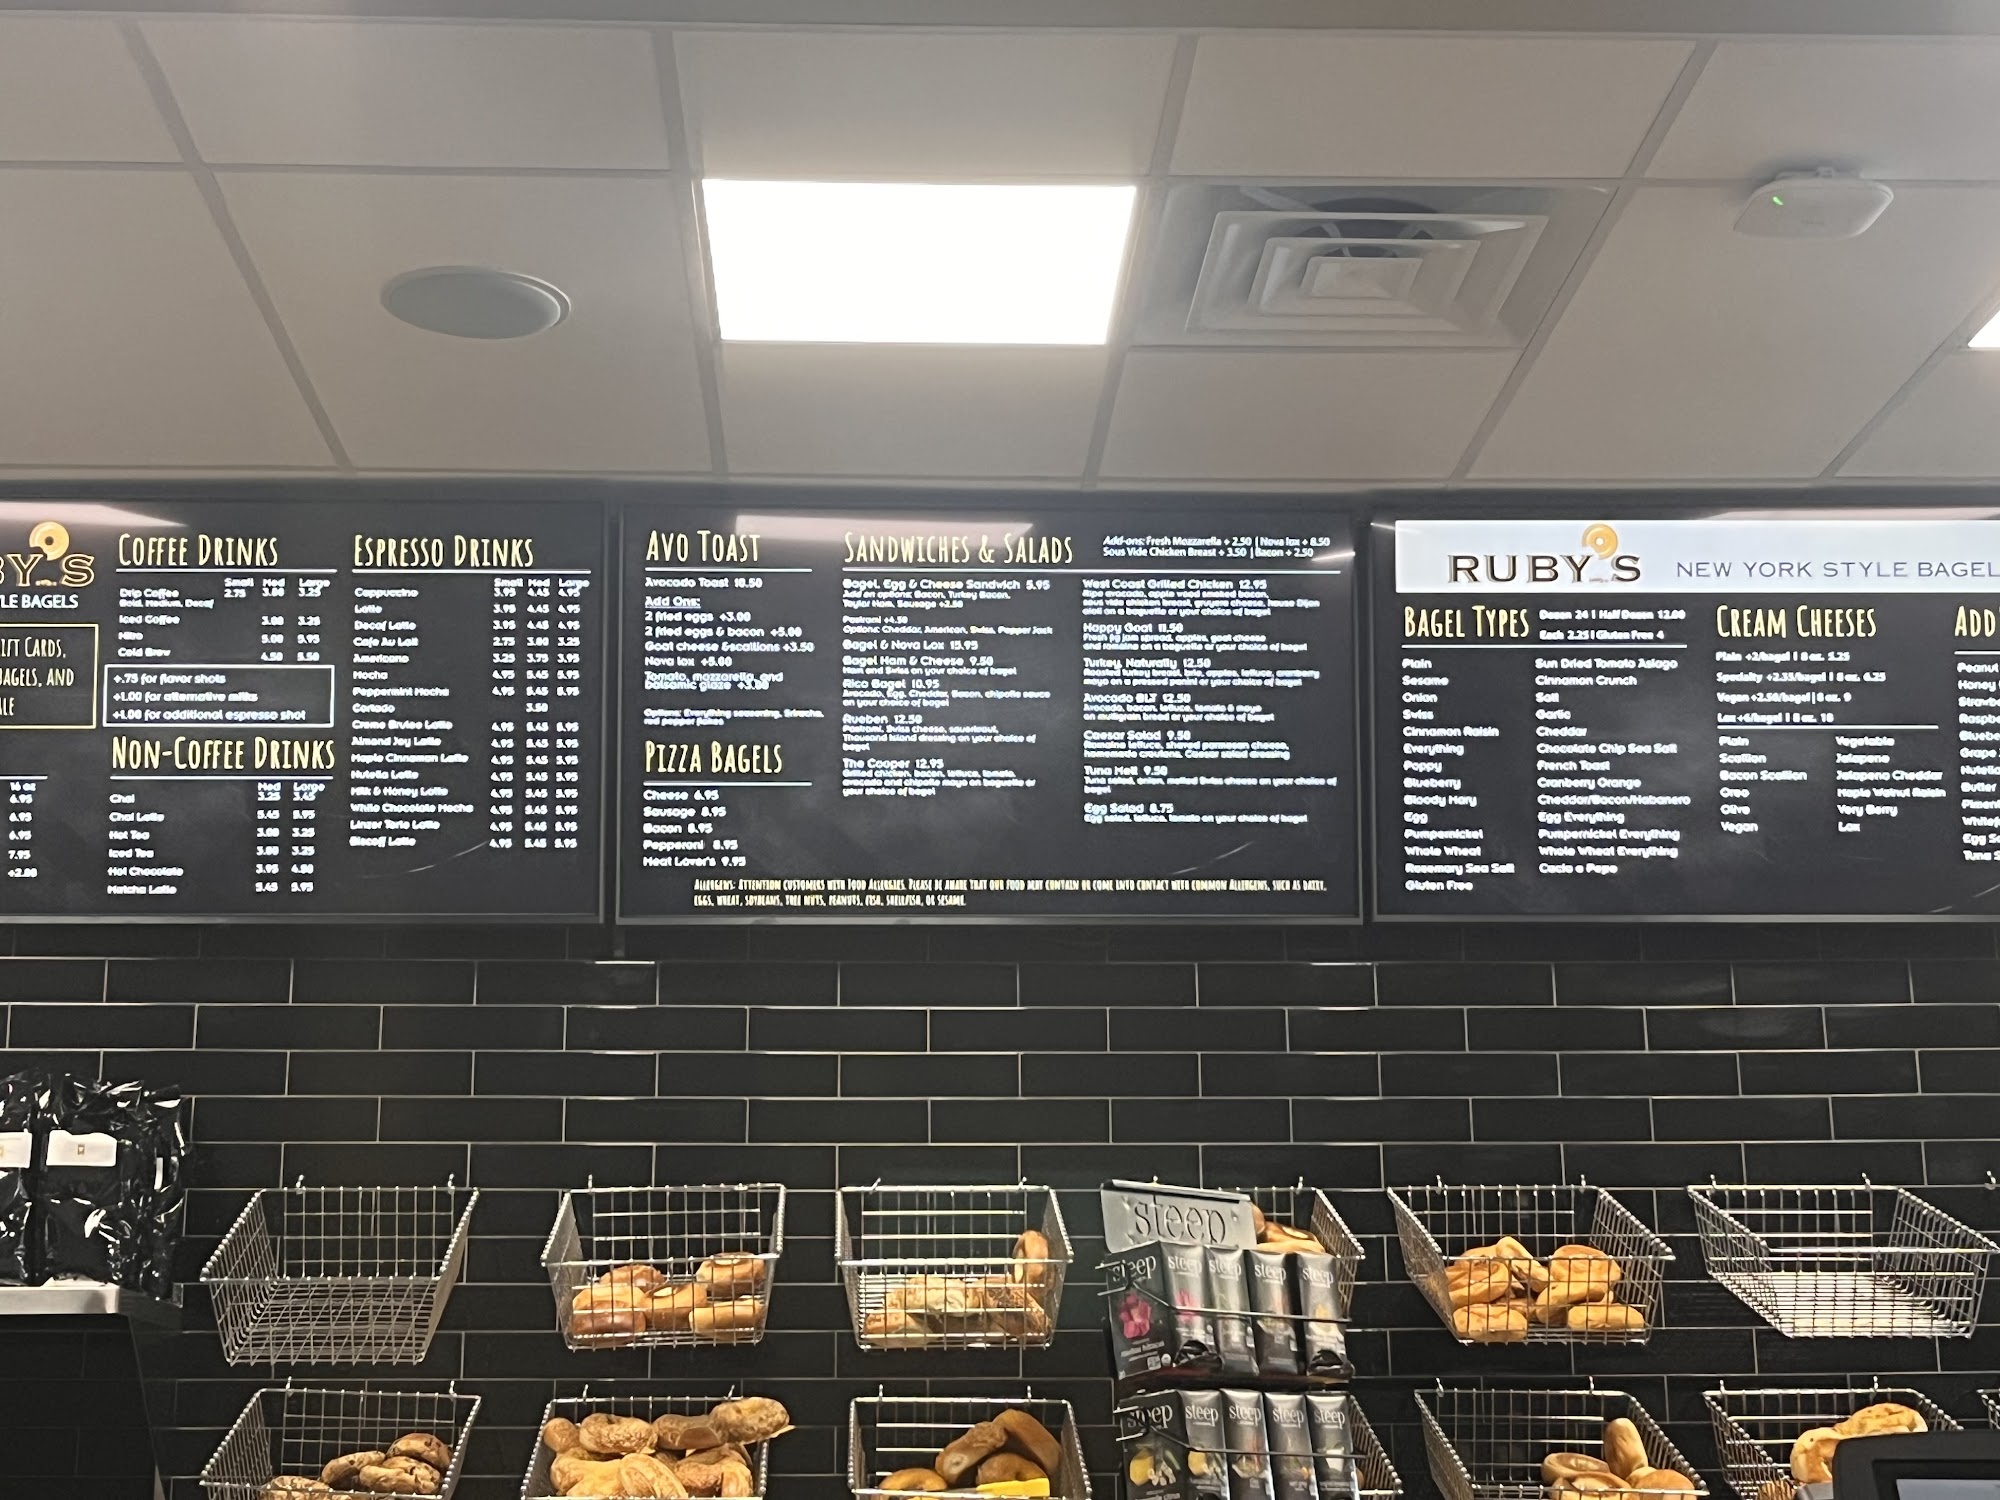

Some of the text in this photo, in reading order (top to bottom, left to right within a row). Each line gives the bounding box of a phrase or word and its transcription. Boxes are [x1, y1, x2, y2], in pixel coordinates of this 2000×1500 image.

[646, 529, 762, 562] AVO TOAST
[842, 530, 1072, 563] SANDWICHES & SALADS
[1146, 536, 1171, 548] Fresh
[1232, 537, 1253, 548] 2.50
[119, 533, 277, 566] COFFEE DRINKS
[355, 535, 533, 567] ESPRESSO DRINKS
[1147, 547, 1186, 556] Chicken
[1188, 547, 1216, 556] Breast
[1294, 548, 1315, 559] 2.50
[1676, 561, 1732, 579] NEW
[1743, 561, 1812, 579] YORK
[1823, 561, 1908, 579] STYLE
[645, 577, 696, 587] Avocado
[698, 577, 729, 587] Toast
[918, 579, 963, 592] Cheese
[966, 579, 1020, 592] Sandwich
[1082, 579, 1110, 591] West
[1112, 579, 1145, 591] Coast
[1147, 579, 1185, 591] Grilled
[1188, 579, 1235, 591] Chicken
[144, 589, 179, 600] Coffee
[355, 588, 418, 598] Cappuccino
[0, 594, 78, 608] LE BAGELS
[645, 596, 671, 608] Add
[655, 611, 682, 623] fried
[684, 613, 714, 624] eggs
[720, 612, 751, 622] +3.00
[1405, 605, 1529, 637] BAGEL TYPES
[1717, 605, 1876, 638] CREAM CHEESES
[655, 626, 682, 638] fried
[684, 628, 713, 638] eggs
[727, 627, 764, 637] bacon
[25, 637, 66, 658] CARDS,
[645, 641, 674, 651] Goat
[676, 642, 719, 651] cheese
[891, 640, 920, 650] Nova
[923, 641, 944, 650] Lox
[645, 656, 674, 666] Nova
[677, 657, 694, 666] lox
[1535, 658, 1558, 668] Sun
[1561, 658, 1592, 668] Dried
[1594, 658, 1636, 668] Tomato
[46, 668, 74, 686] AND
[141, 673, 157, 685] for
[192, 674, 226, 684] shots
[1535, 675, 1637, 685] Cinnamon Crunch
[144, 709, 161, 721] for
[163, 710, 223, 720] additional
[225, 711, 278, 721] espresso
[280, 710, 306, 720] shot
[1084, 730, 1125, 742] Caesar
[1127, 730, 1161, 742] Salad
[1403, 726, 1461, 736] Cinnamon
[113, 736, 334, 769] NON-COFFEE DRINKS
[646, 741, 782, 773] PIZZA BAGELS
[843, 758, 864, 771] The
[867, 758, 910, 771] Cooper
[1579, 760, 1610, 771] Toast
[1110, 803, 1146, 816] Salad
[1133, 1199, 1227, 1244] steep
[1254, 1262, 1287, 1284] steep
[1185, 1404, 1219, 1428] steep
[1272, 1406, 1304, 1428] steep
[1314, 1407, 1346, 1428] steep
